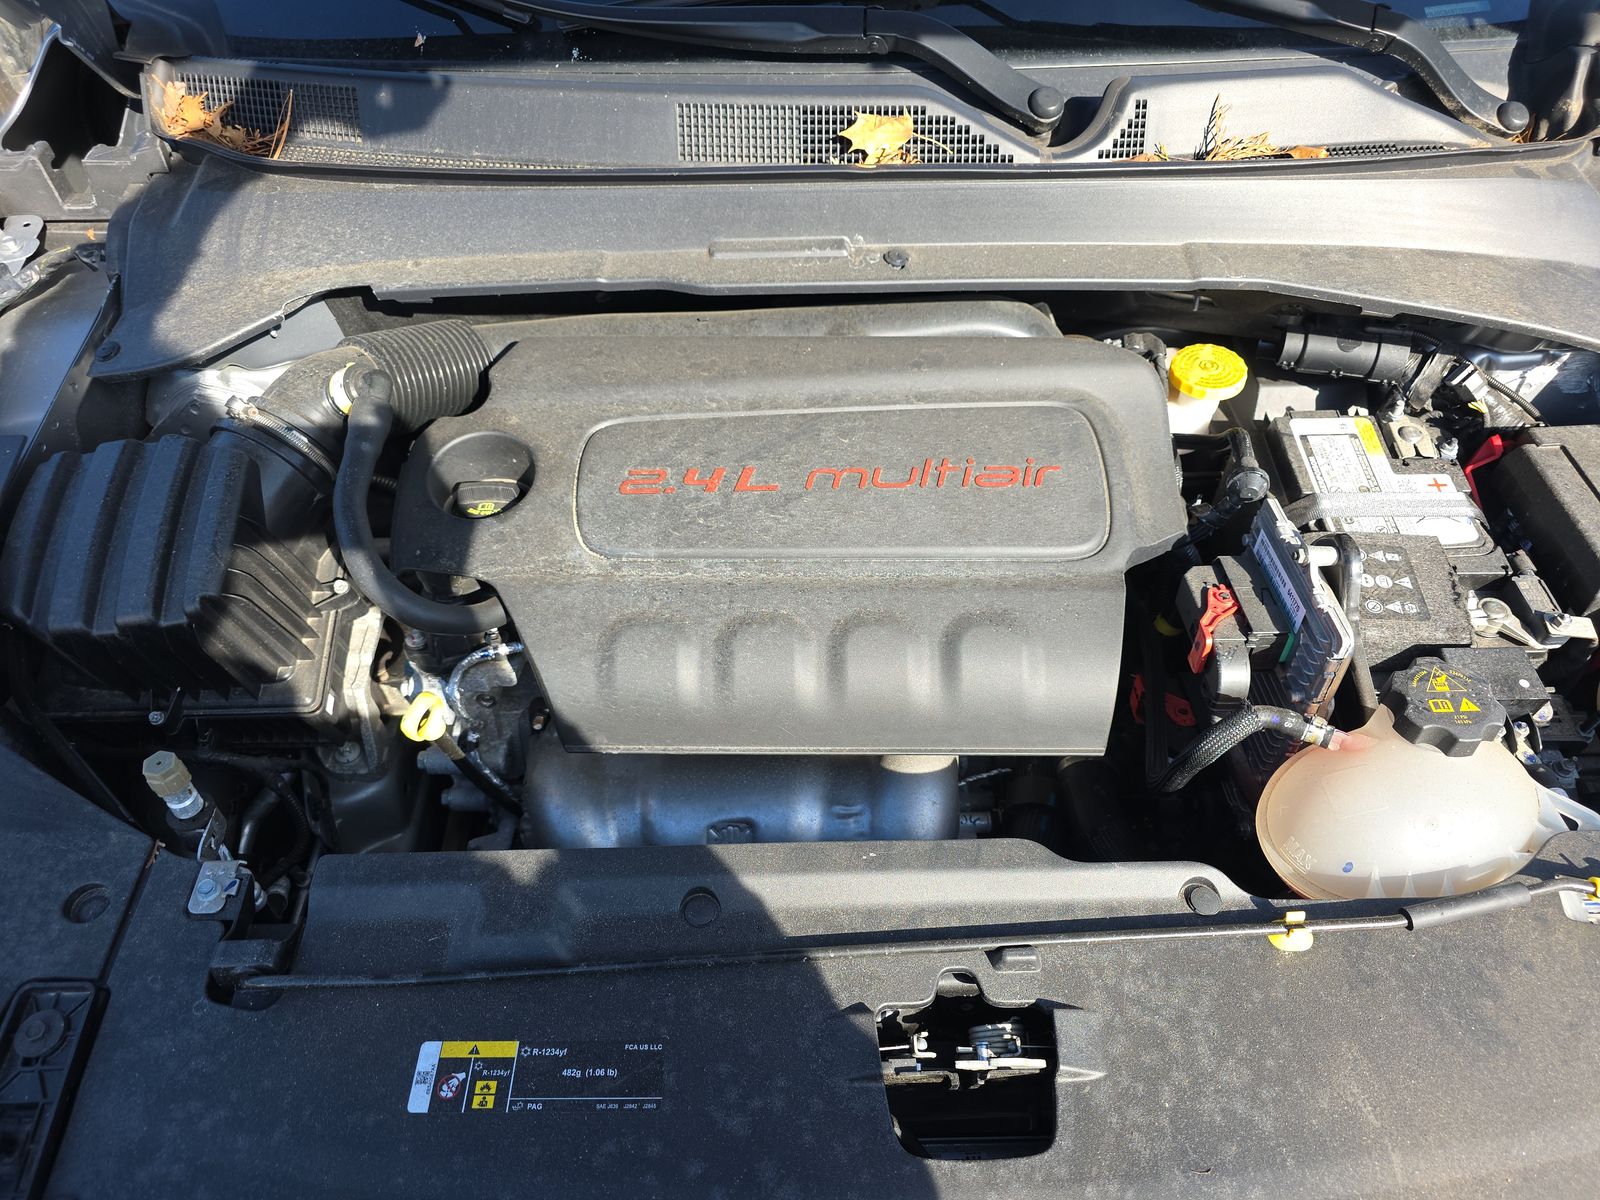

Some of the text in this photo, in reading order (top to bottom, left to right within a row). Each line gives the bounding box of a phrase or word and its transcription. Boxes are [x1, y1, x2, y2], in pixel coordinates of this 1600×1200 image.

[619, 457, 1062, 494] 2.4L multiair
[532, 1047, 568, 1058] R-1234yf
[482, 1069, 511, 1077] R-1234yf
[562, 1068, 618, 1078] 482g (1.06 lb)
[527, 1102, 543, 1110] PAG
